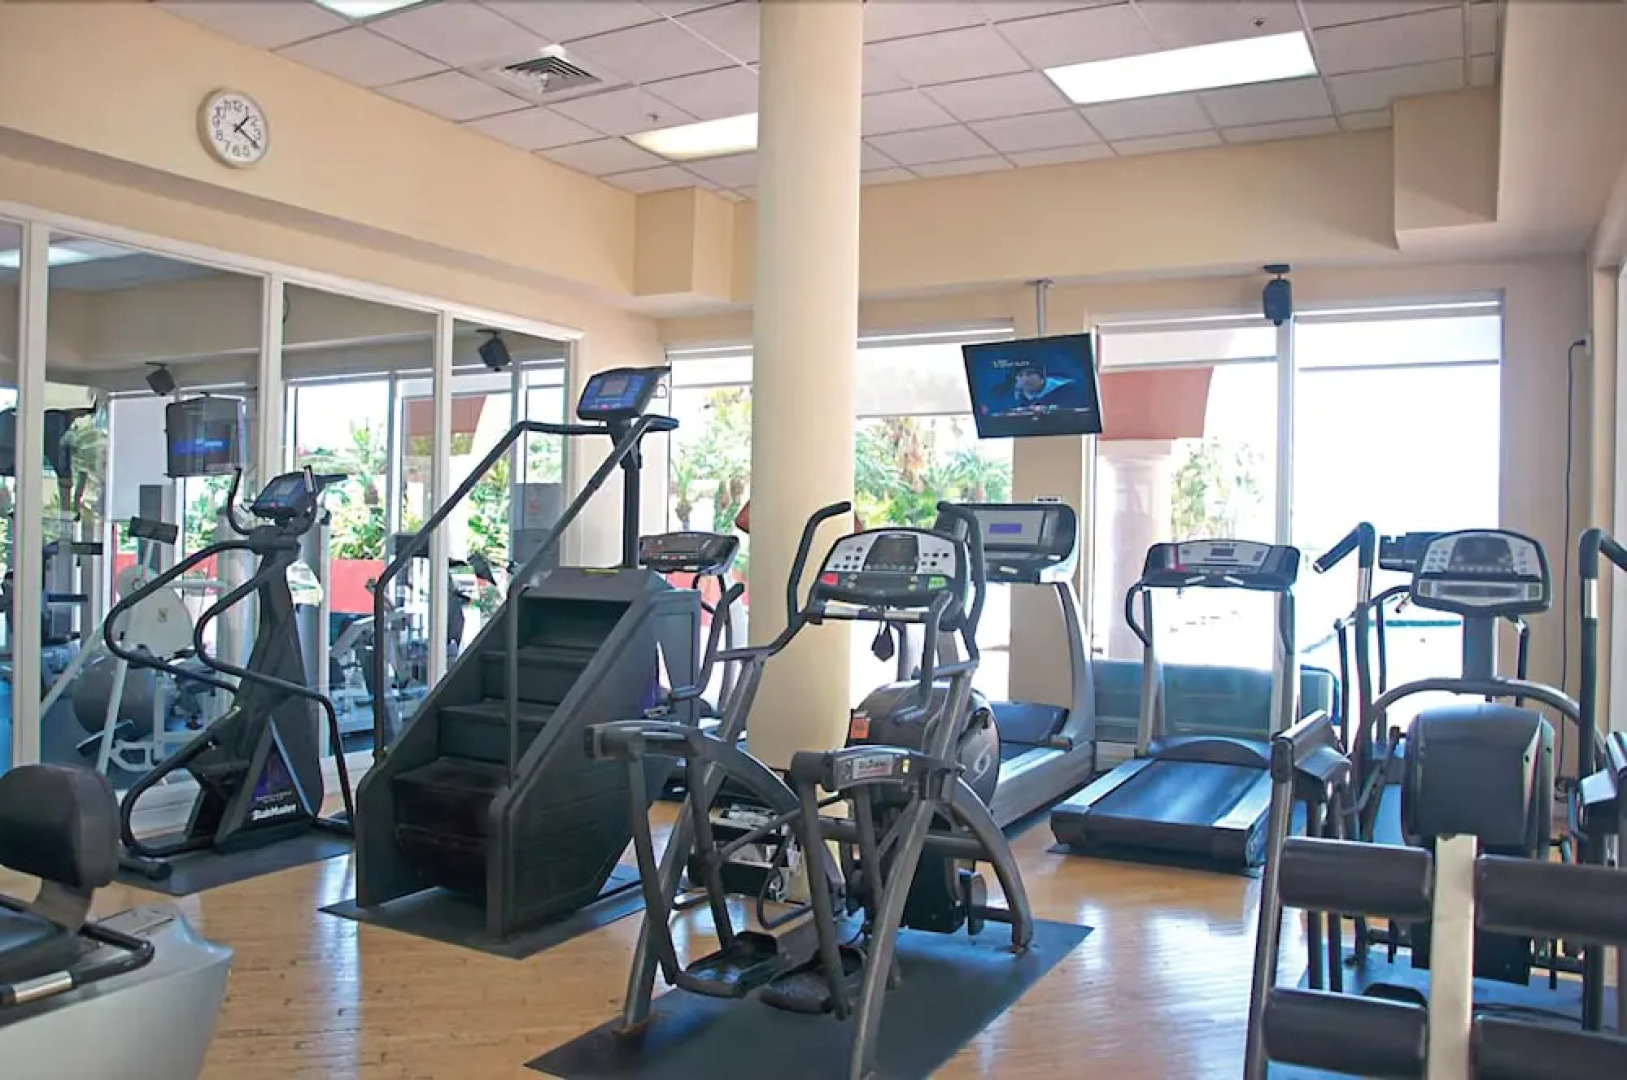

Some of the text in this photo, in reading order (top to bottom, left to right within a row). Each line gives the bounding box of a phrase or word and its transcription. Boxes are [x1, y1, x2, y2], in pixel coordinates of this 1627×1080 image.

[233, 100, 243, 112] 12
[253, 128, 261, 140] 3
[223, 139, 231, 152] 7
